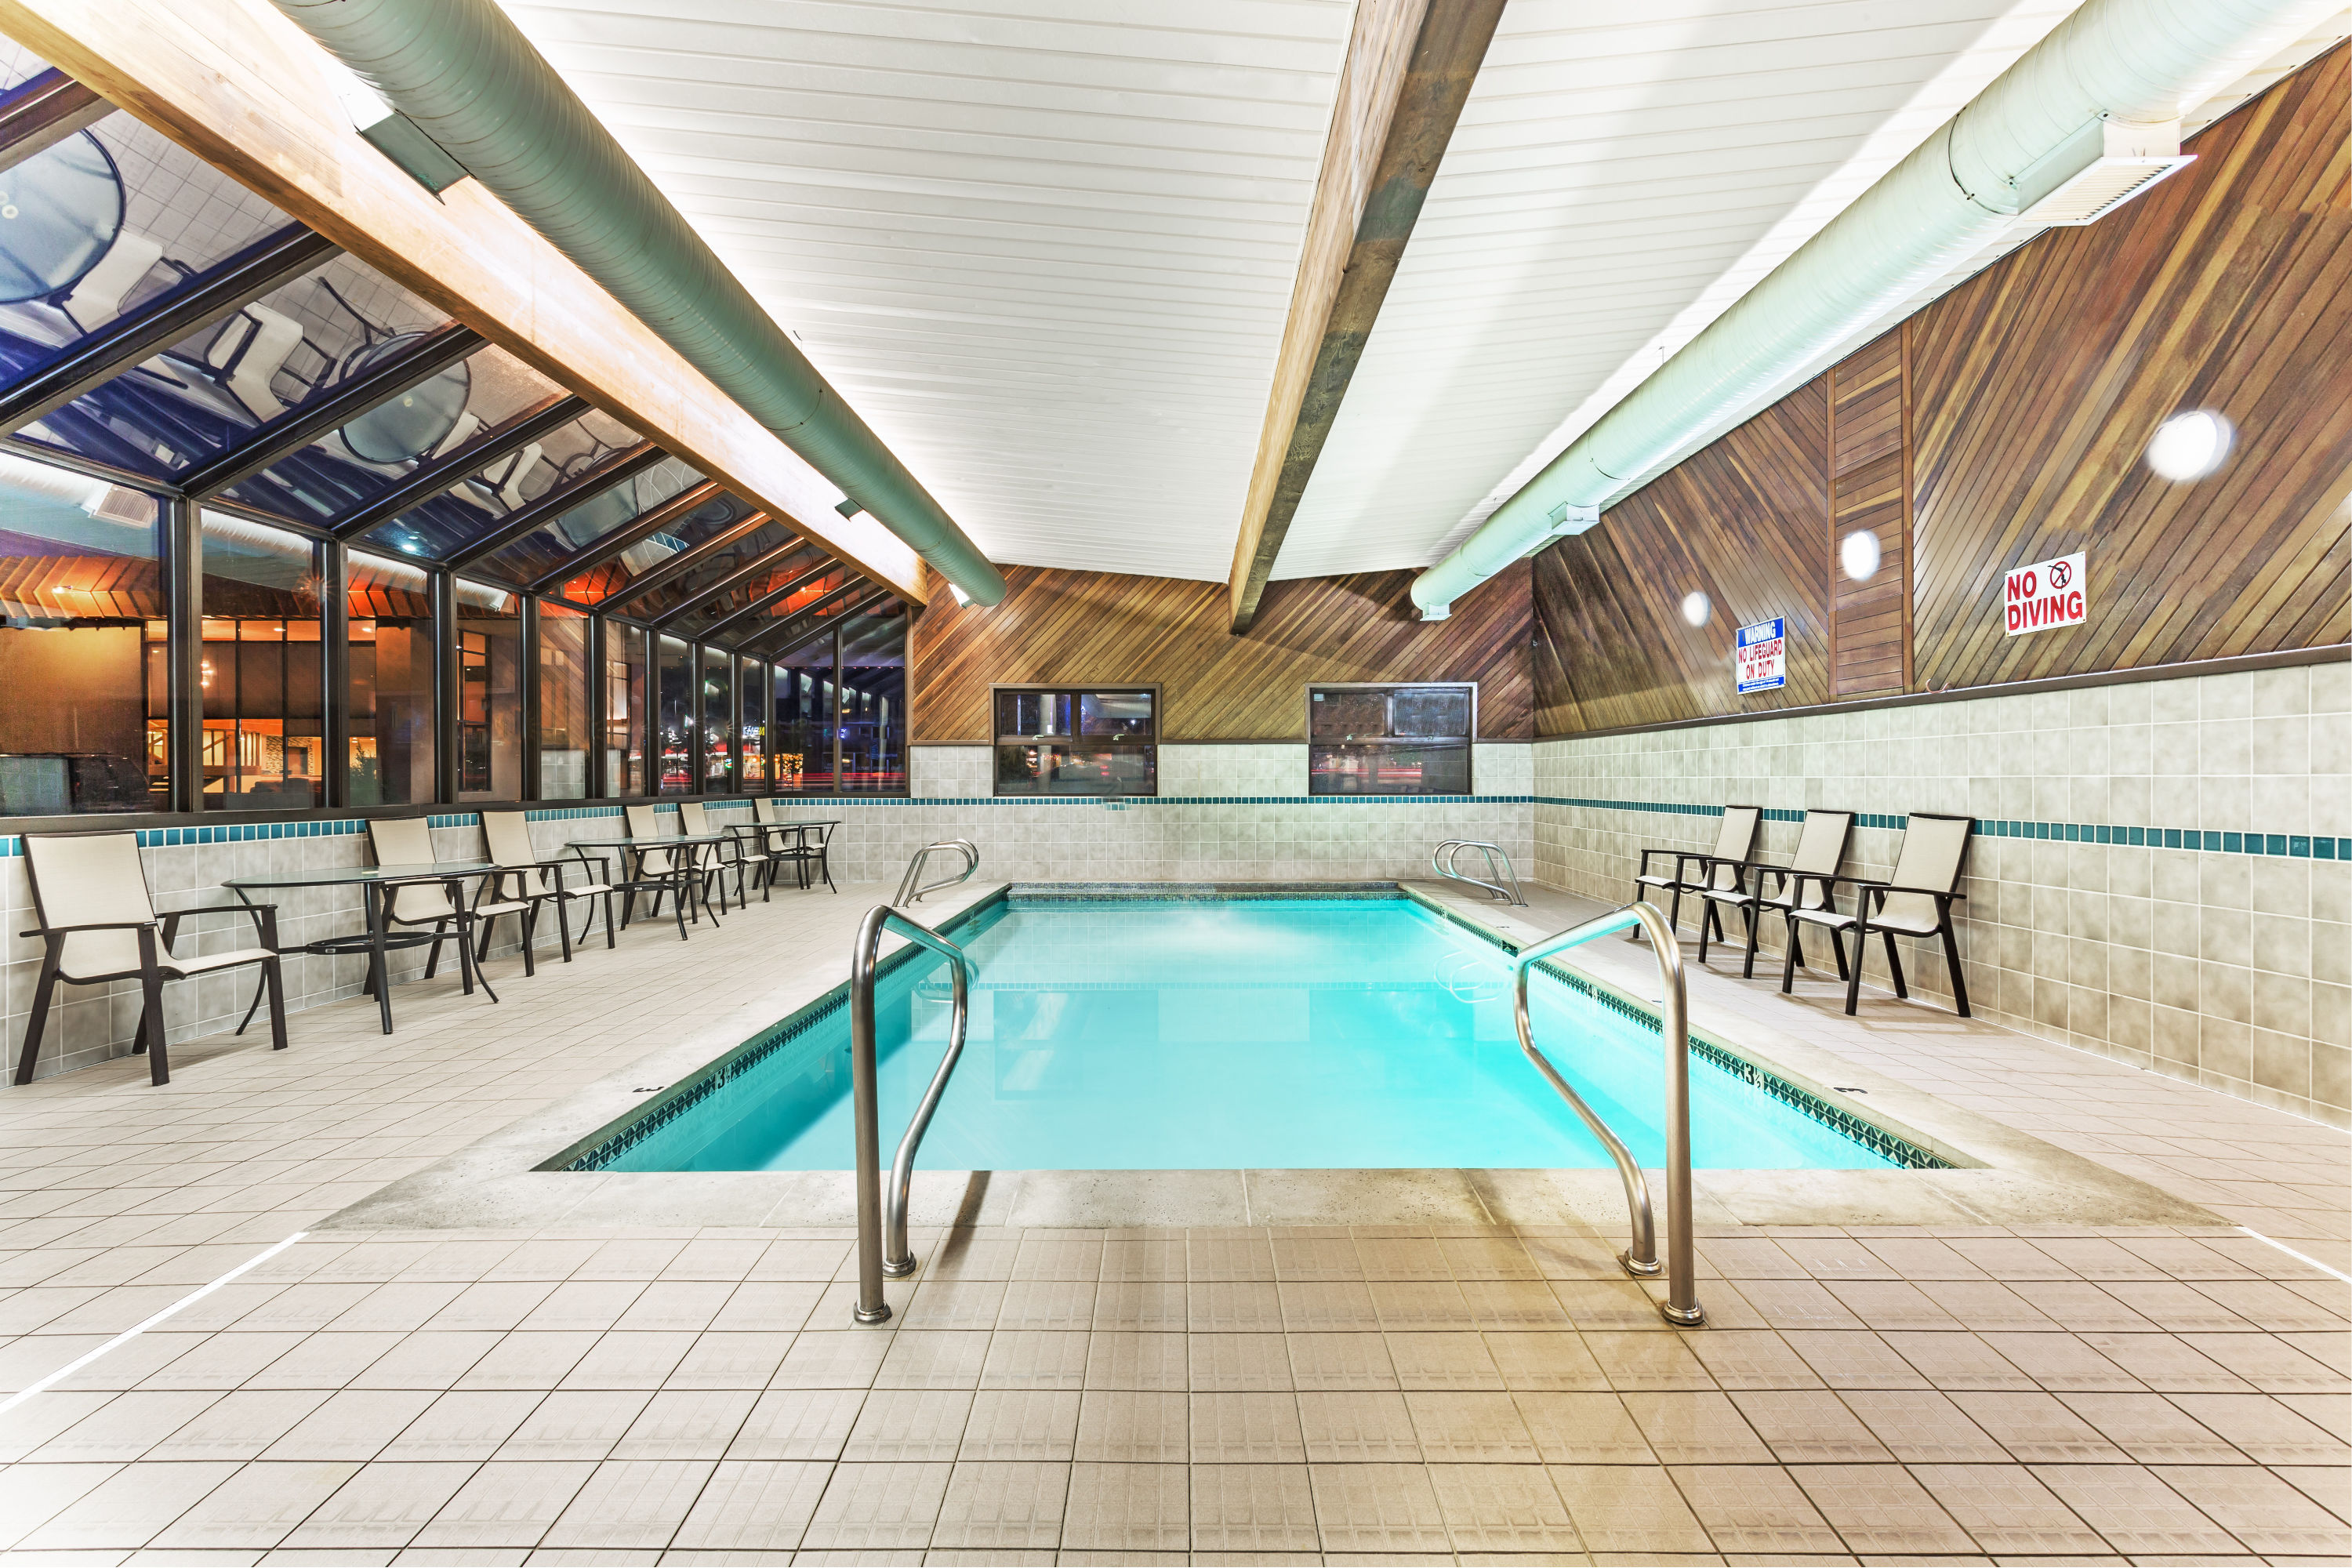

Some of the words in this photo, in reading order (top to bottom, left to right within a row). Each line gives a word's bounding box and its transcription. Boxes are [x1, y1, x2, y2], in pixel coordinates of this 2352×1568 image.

[2007, 571, 2037, 602] NO
[2007, 590, 2083, 631] DIVING
[1744, 621, 1776, 644] WARNING
[1738, 648, 1748, 663] NO
[1749, 639, 1782, 661] LIFEGUARD
[1746, 663, 1755, 680] ON
[1759, 659, 1774, 677] DUTY
[1745, 1063, 1755, 1086] 3
